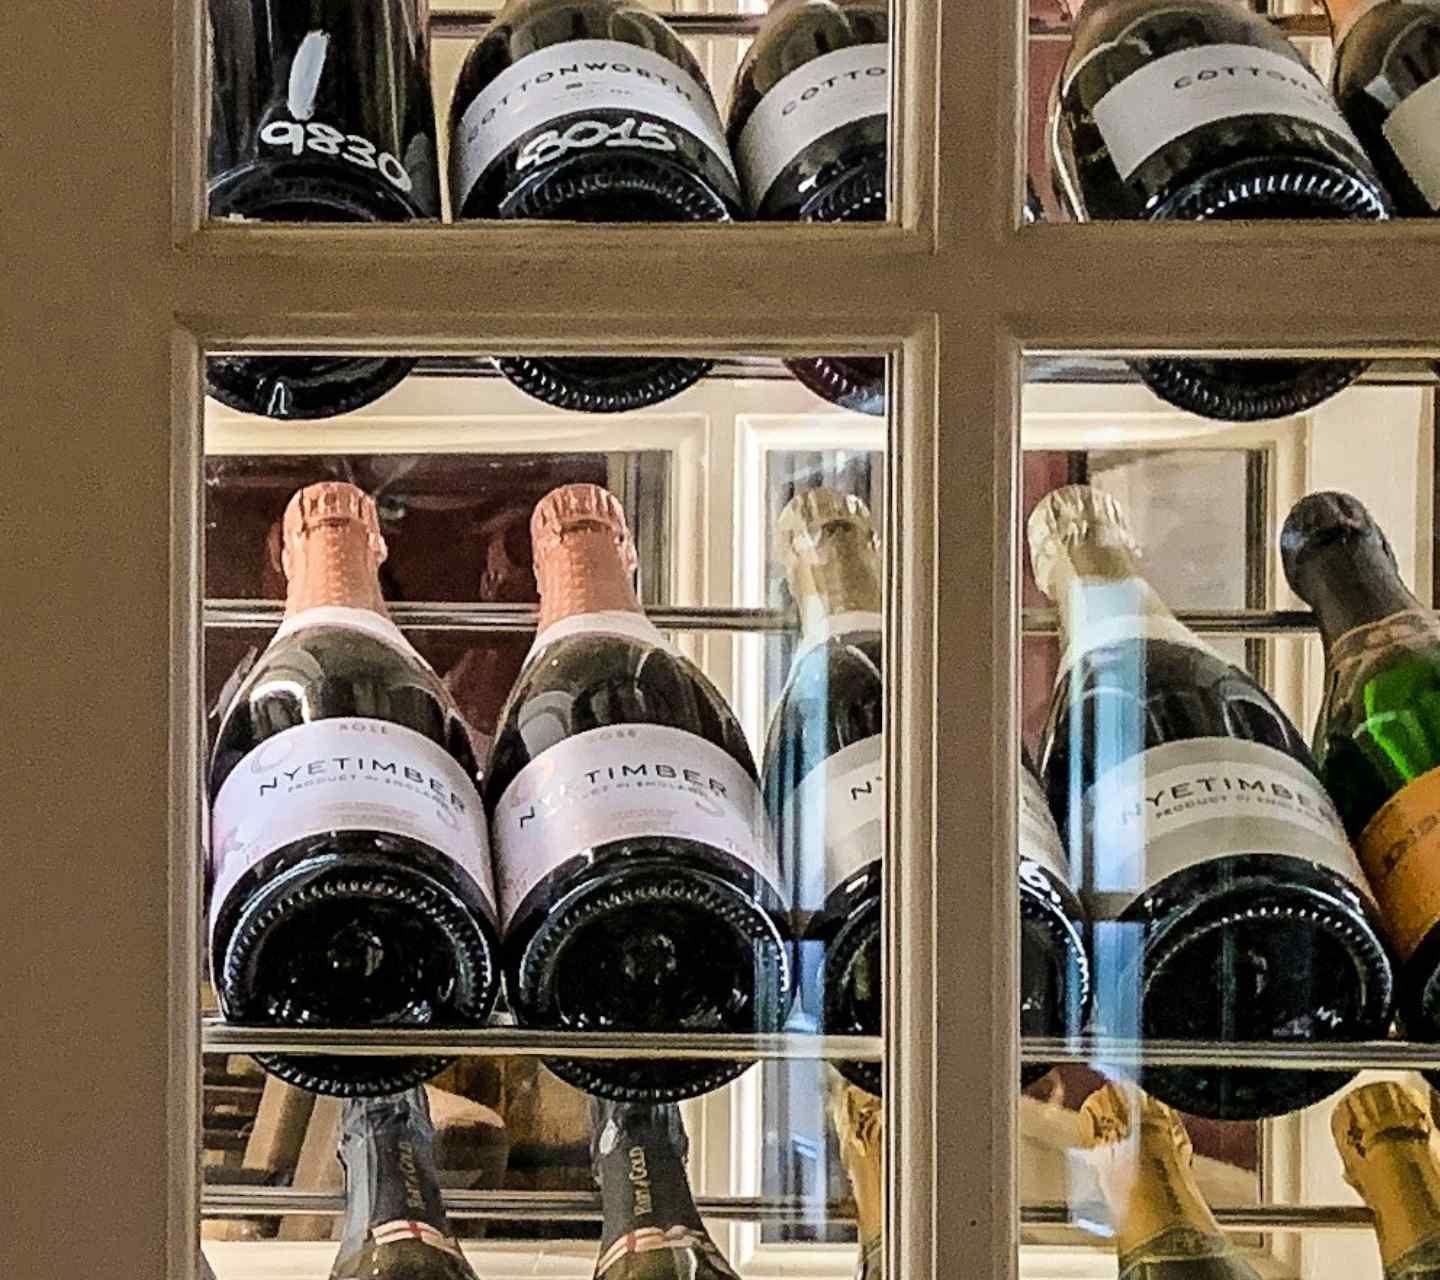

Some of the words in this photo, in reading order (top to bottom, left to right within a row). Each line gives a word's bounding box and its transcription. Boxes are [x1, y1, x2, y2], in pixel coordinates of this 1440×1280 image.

[466, 62, 694, 144] COTTONWORTH
[260, 120, 413, 192] 9830
[259, 757, 467, 816] NYETIMBER
[850, 776, 883, 801] N
